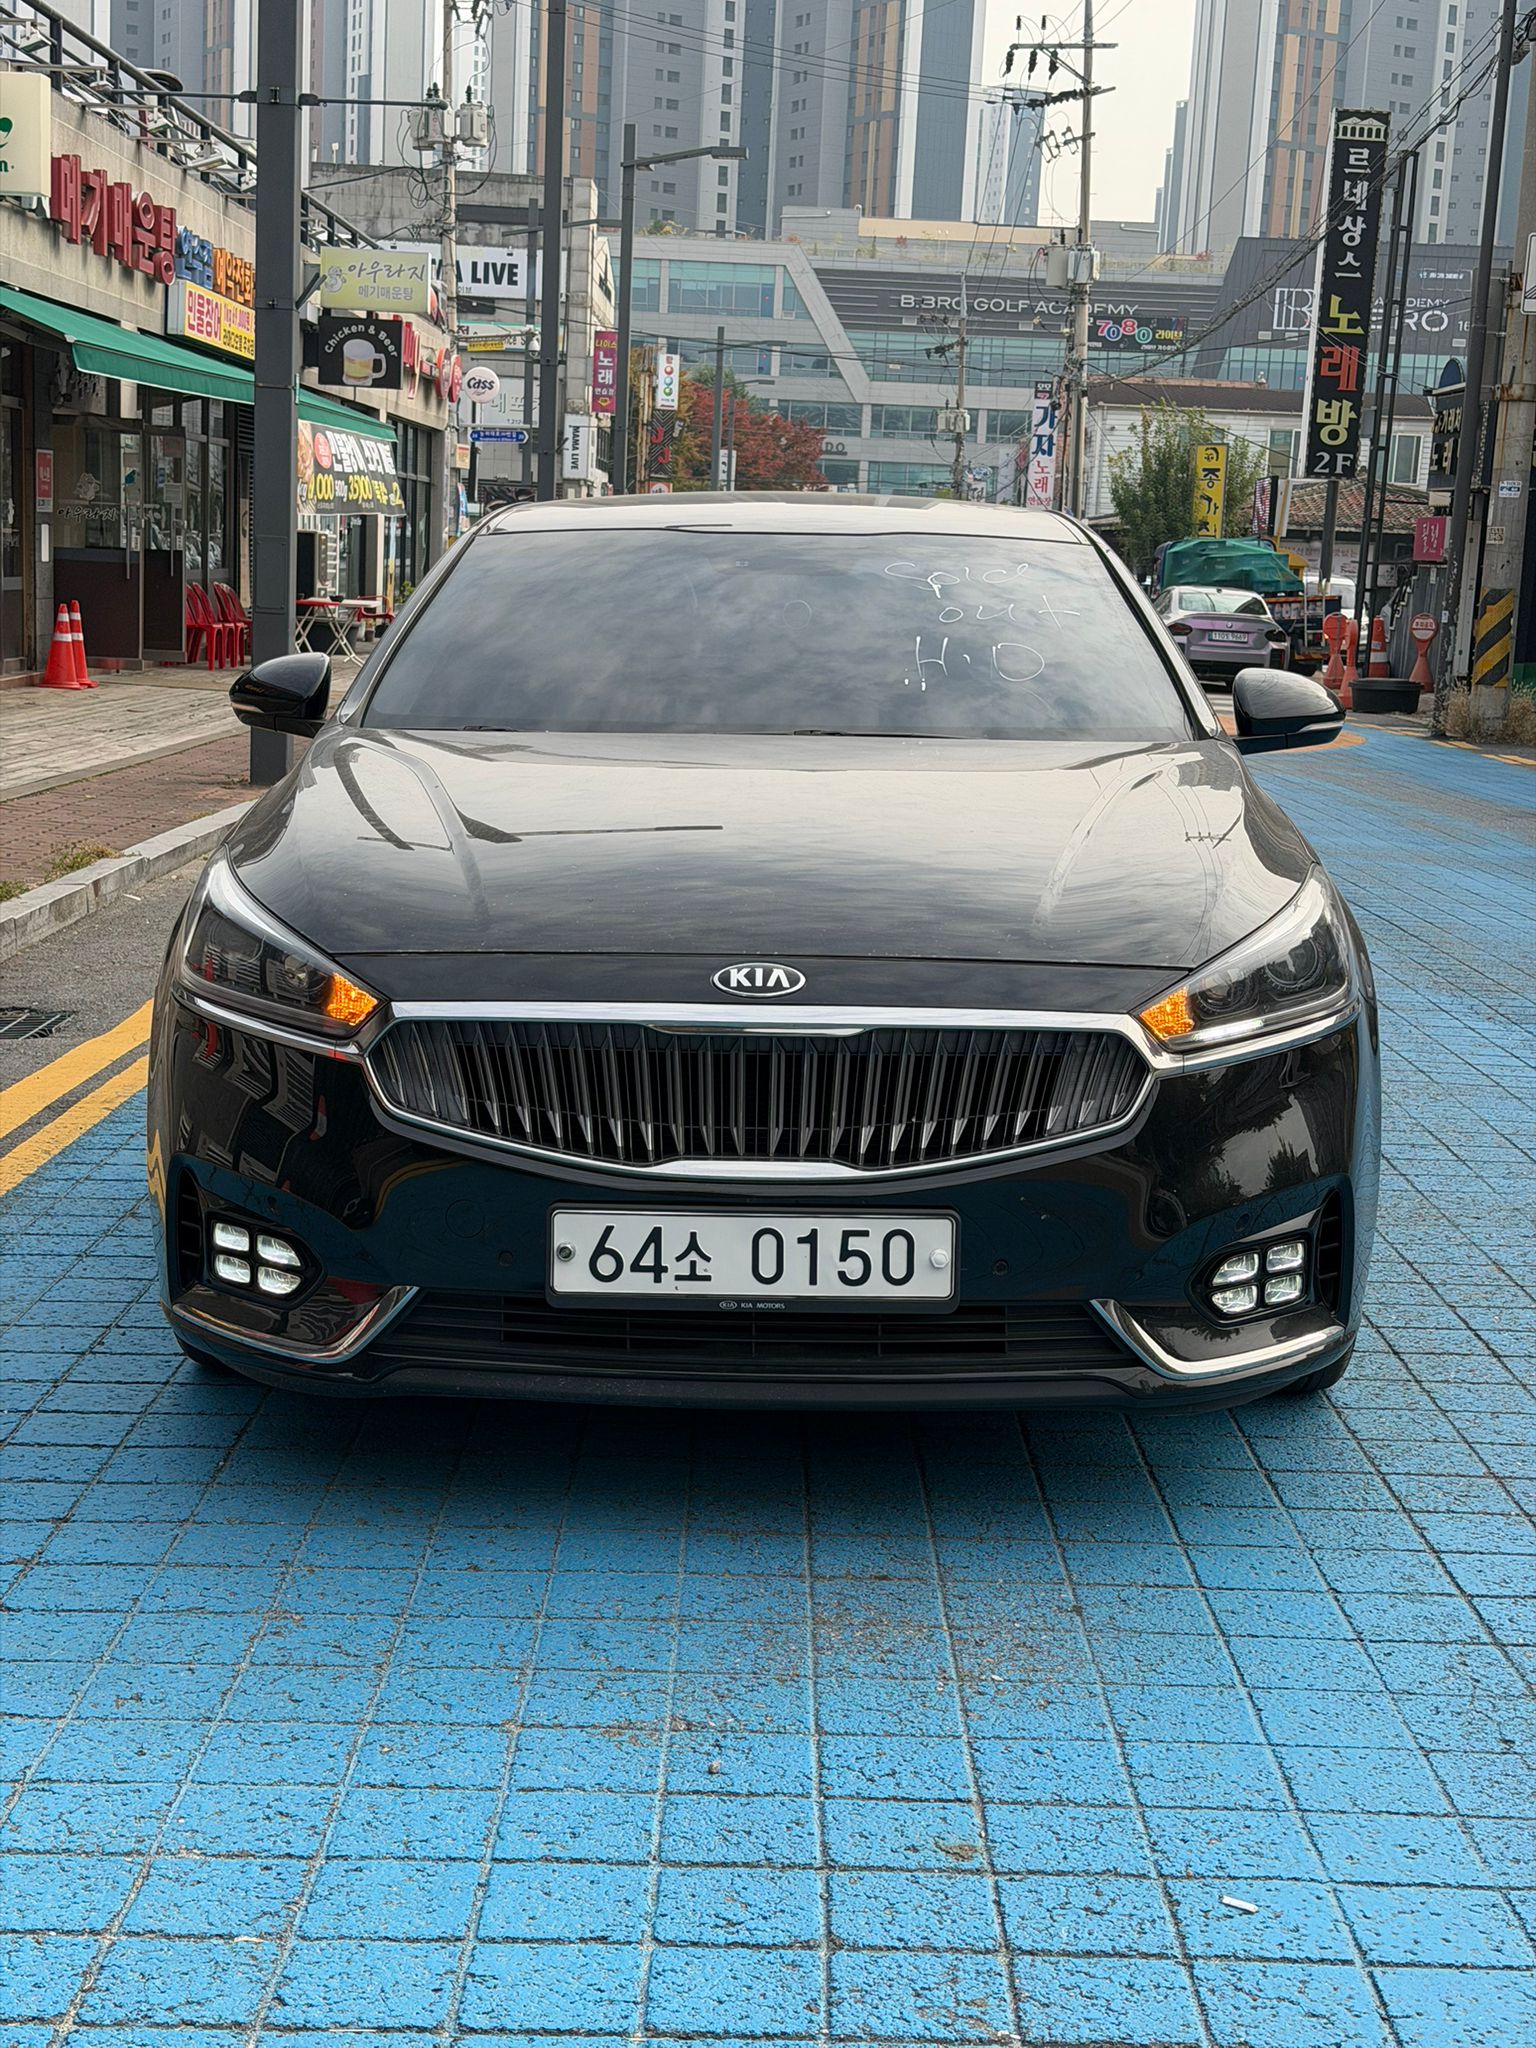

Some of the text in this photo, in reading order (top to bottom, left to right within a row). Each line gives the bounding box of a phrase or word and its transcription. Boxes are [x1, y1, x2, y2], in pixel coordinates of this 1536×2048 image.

[51, 154, 176, 285] 메기매운탕
[1334, 148, 1371, 279] 르네상스
[348, 261, 425, 283] 아우라지
[471, 261, 519, 286] LIVE
[358, 285, 413, 301] 메기매운탕
[973, 298, 1030, 312] GOLF
[1373, 295, 1450, 308] ADEMY
[325, 324, 399, 358] Chicken & Beer
[1096, 318, 1152, 343] 7080
[598, 351, 614, 384] 노래
[1315, 294, 1365, 446] 노래방
[467, 377, 495, 391] Cass
[1031, 405, 1058, 457] 가자
[571, 426, 580, 470] MAMA LIVE
[1313, 451, 1354, 475] 2F
[1033, 460, 1050, 493] 노래
[58, 505, 118, 521] 아우라지
[729, 968, 790, 988] KIA
[589, 1224, 915, 1287] 64소 0150
